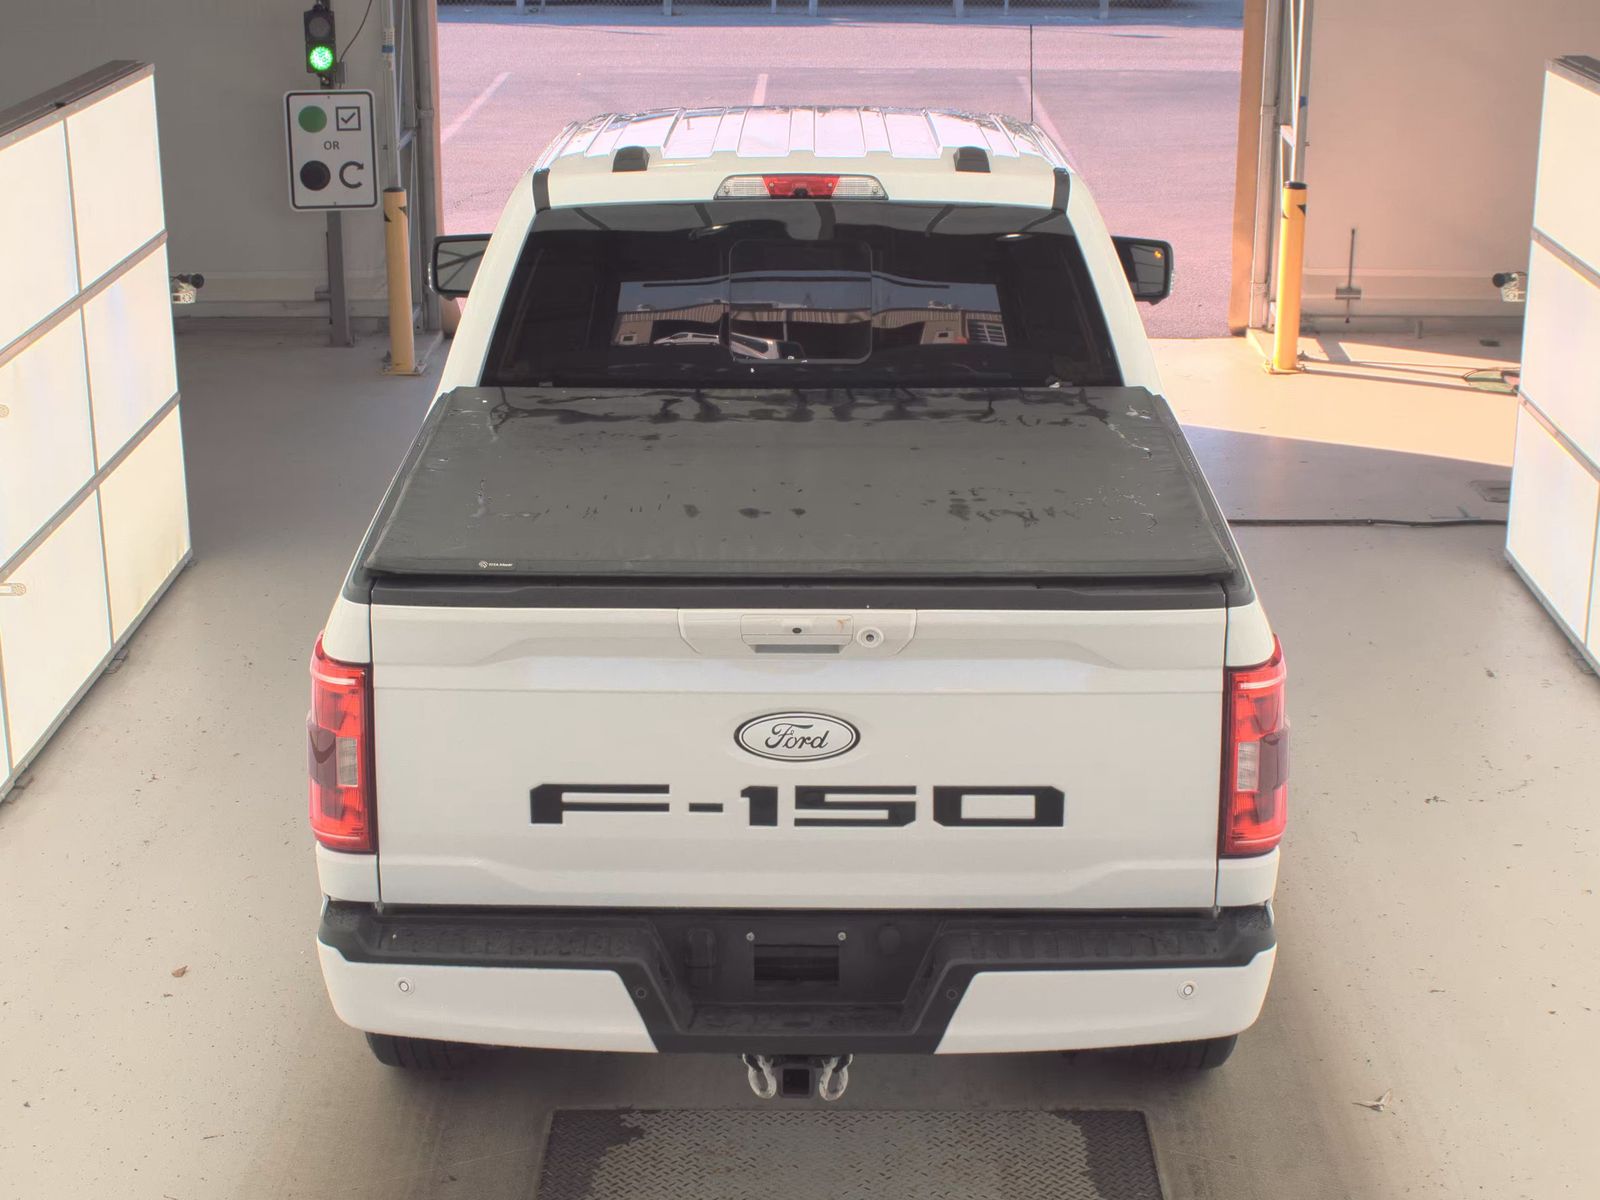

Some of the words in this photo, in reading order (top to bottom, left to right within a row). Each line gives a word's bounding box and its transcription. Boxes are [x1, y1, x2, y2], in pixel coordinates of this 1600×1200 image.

[323, 141, 340, 151] OR
[764, 723, 829, 749] Ford
[530, 783, 1065, 827] F-150
